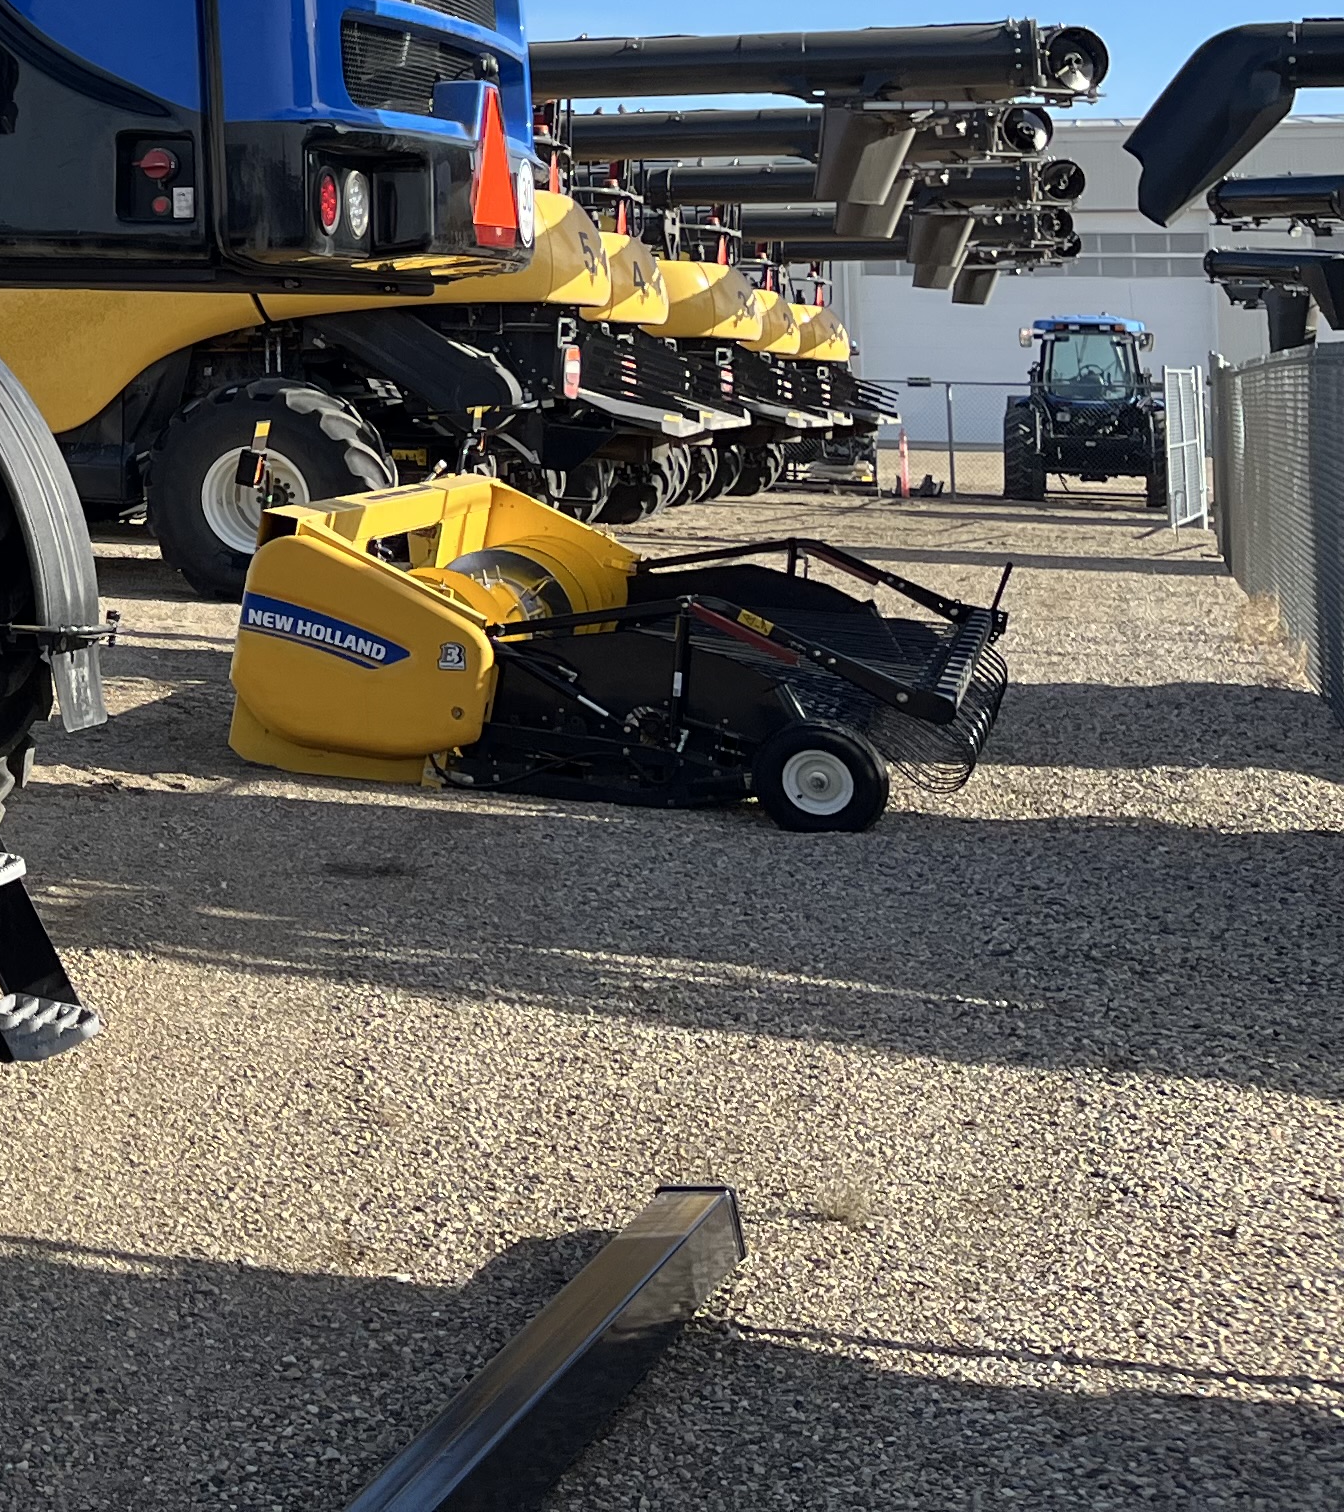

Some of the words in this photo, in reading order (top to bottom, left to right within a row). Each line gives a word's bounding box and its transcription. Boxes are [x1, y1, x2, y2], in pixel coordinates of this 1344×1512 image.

[578, 231, 598, 276] 5
[633, 260, 649, 295] 4
[248, 608, 294, 632] NEW
[296, 619, 387, 661] HOLLAND
